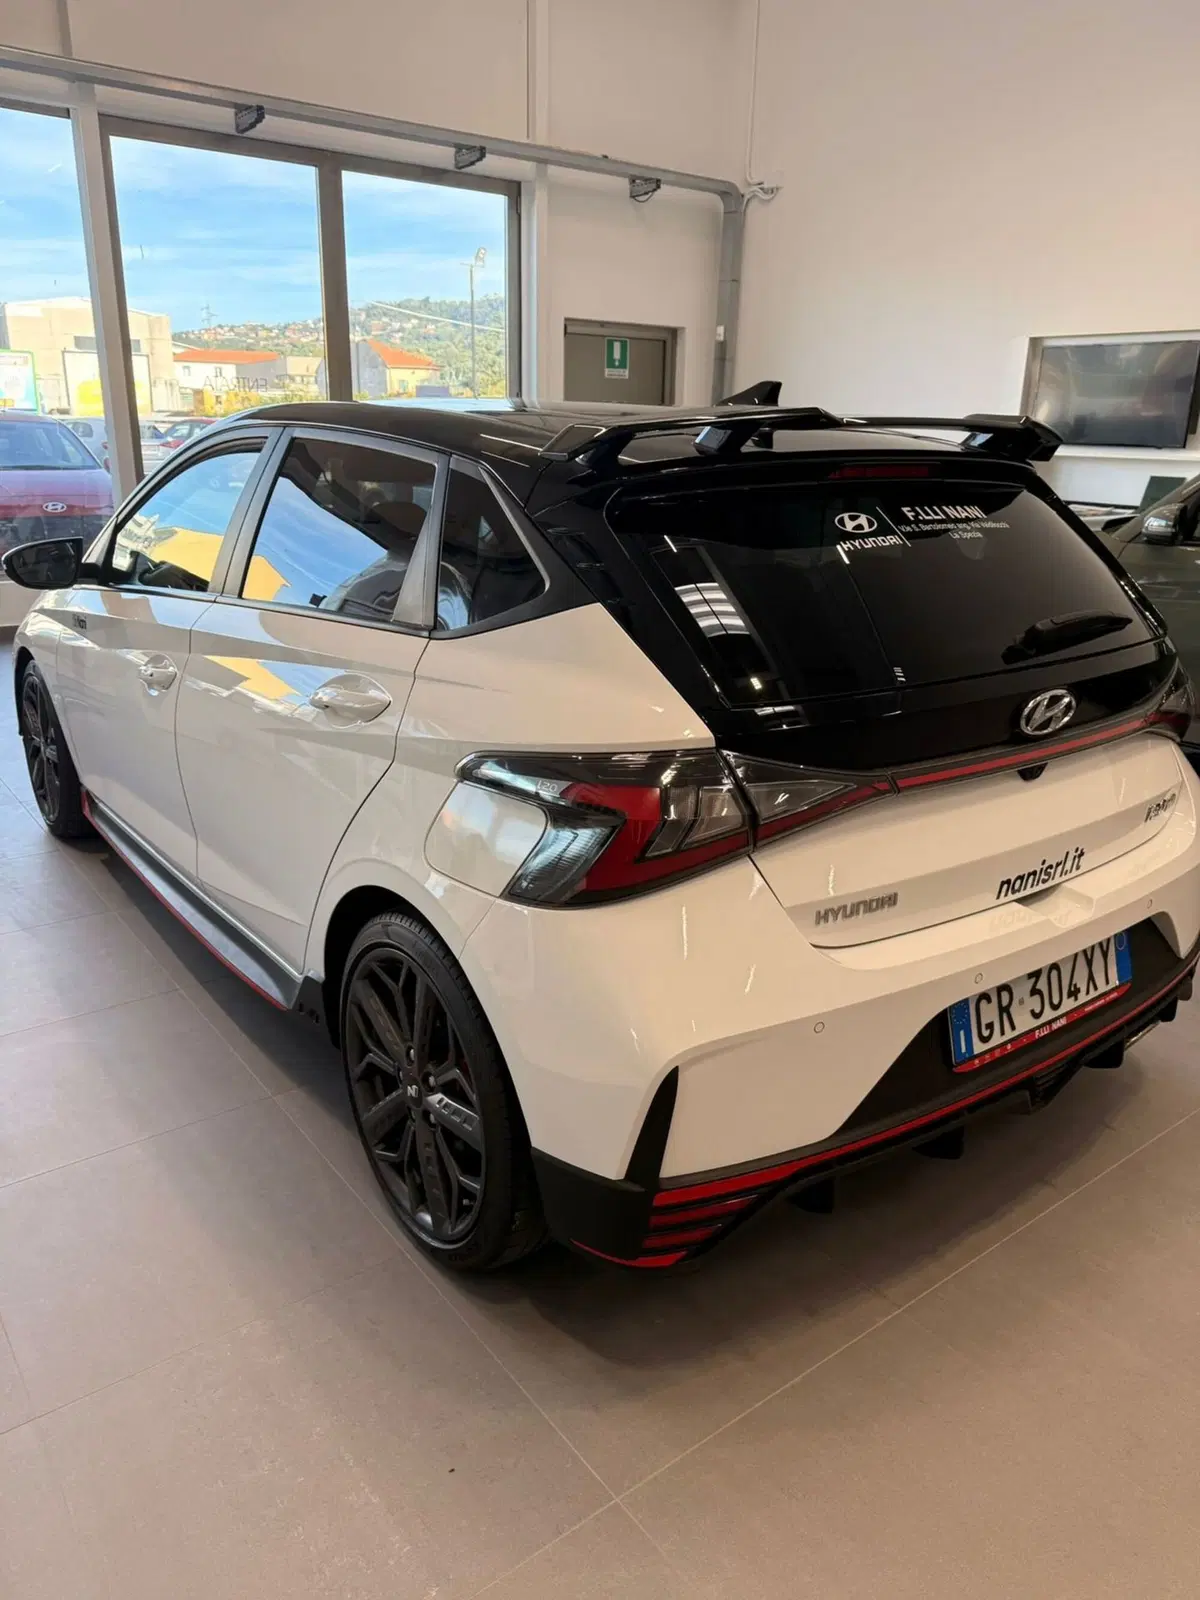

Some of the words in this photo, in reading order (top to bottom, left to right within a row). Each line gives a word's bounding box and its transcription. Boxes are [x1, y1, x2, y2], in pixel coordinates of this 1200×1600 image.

[901, 506, 946, 520] F.LLI
[942, 505, 987, 519] NANI
[840, 535, 903, 551] HYUNDAI
[996, 847, 1085, 900] nanisrl.it
[815, 892, 898, 925] HYUNDAI
[975, 983, 1016, 1044] GR
[1027, 937, 1111, 1020] 304XY
